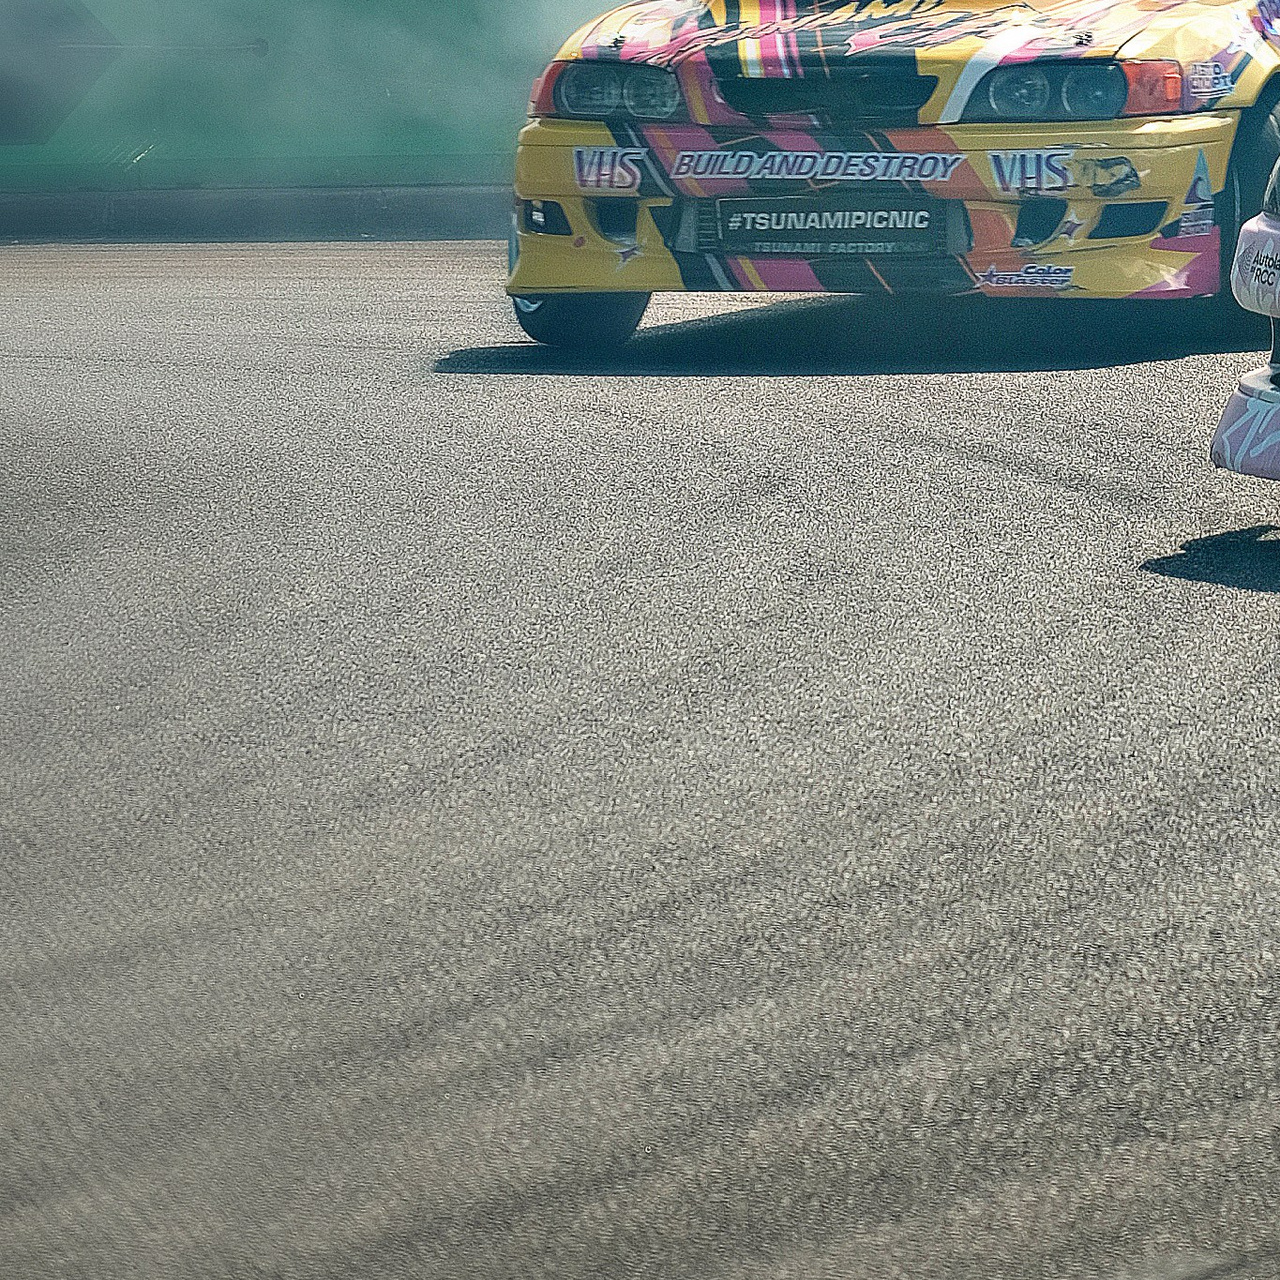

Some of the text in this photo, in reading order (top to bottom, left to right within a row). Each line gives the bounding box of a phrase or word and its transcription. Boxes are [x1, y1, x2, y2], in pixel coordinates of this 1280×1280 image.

[573, 147, 648, 192] VHS
[671, 150, 966, 182] BUILD AND DESTROY
[989, 151, 1073, 194] VHS
[728, 210, 932, 231] #TSUNAMIPICNIC
[752, 241, 897, 254] TSUNAMI FACTORY
[1021, 263, 1075, 276] Color
[1253, 267, 1276, 286] RCC
